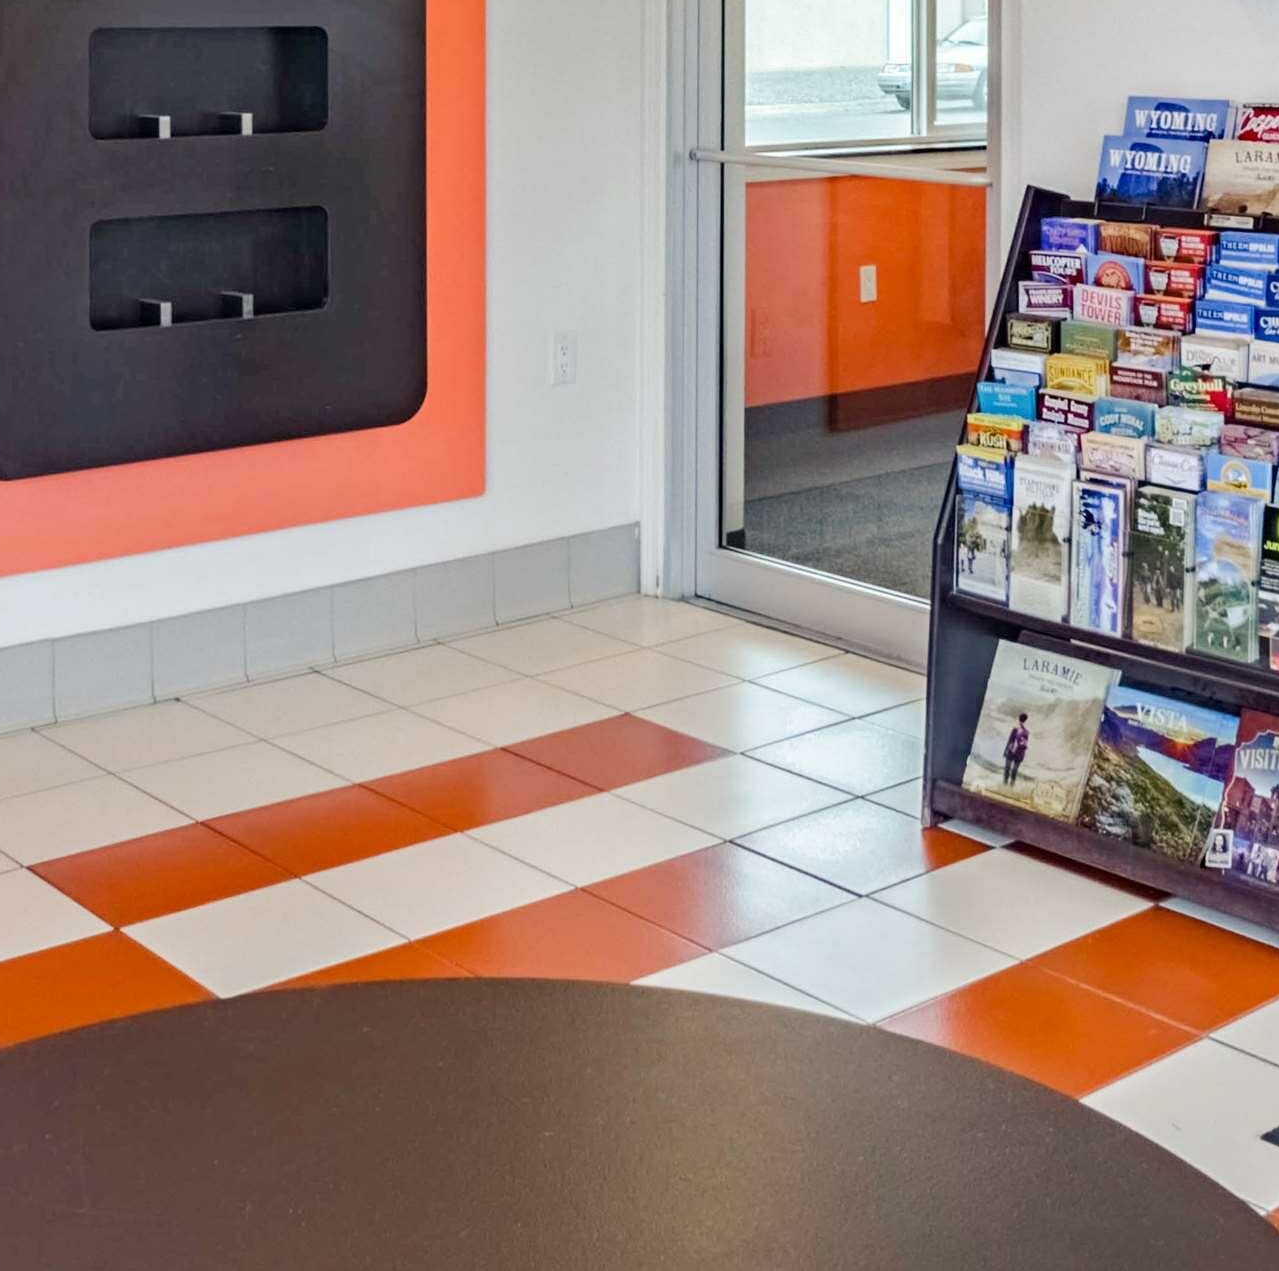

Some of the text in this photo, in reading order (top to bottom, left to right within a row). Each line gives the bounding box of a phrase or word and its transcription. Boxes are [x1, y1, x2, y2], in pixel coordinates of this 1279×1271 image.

[1134, 108, 1217, 132] WYOMING
[1108, 147, 1191, 174] WYOMING
[1081, 289, 1122, 310] DEVILS
[1080, 303, 1120, 324] TOWER
[1170, 378, 1224, 395] Greybull
[1023, 657, 1082, 686] LARAMIE
[1136, 703, 1188, 730] VISTA
